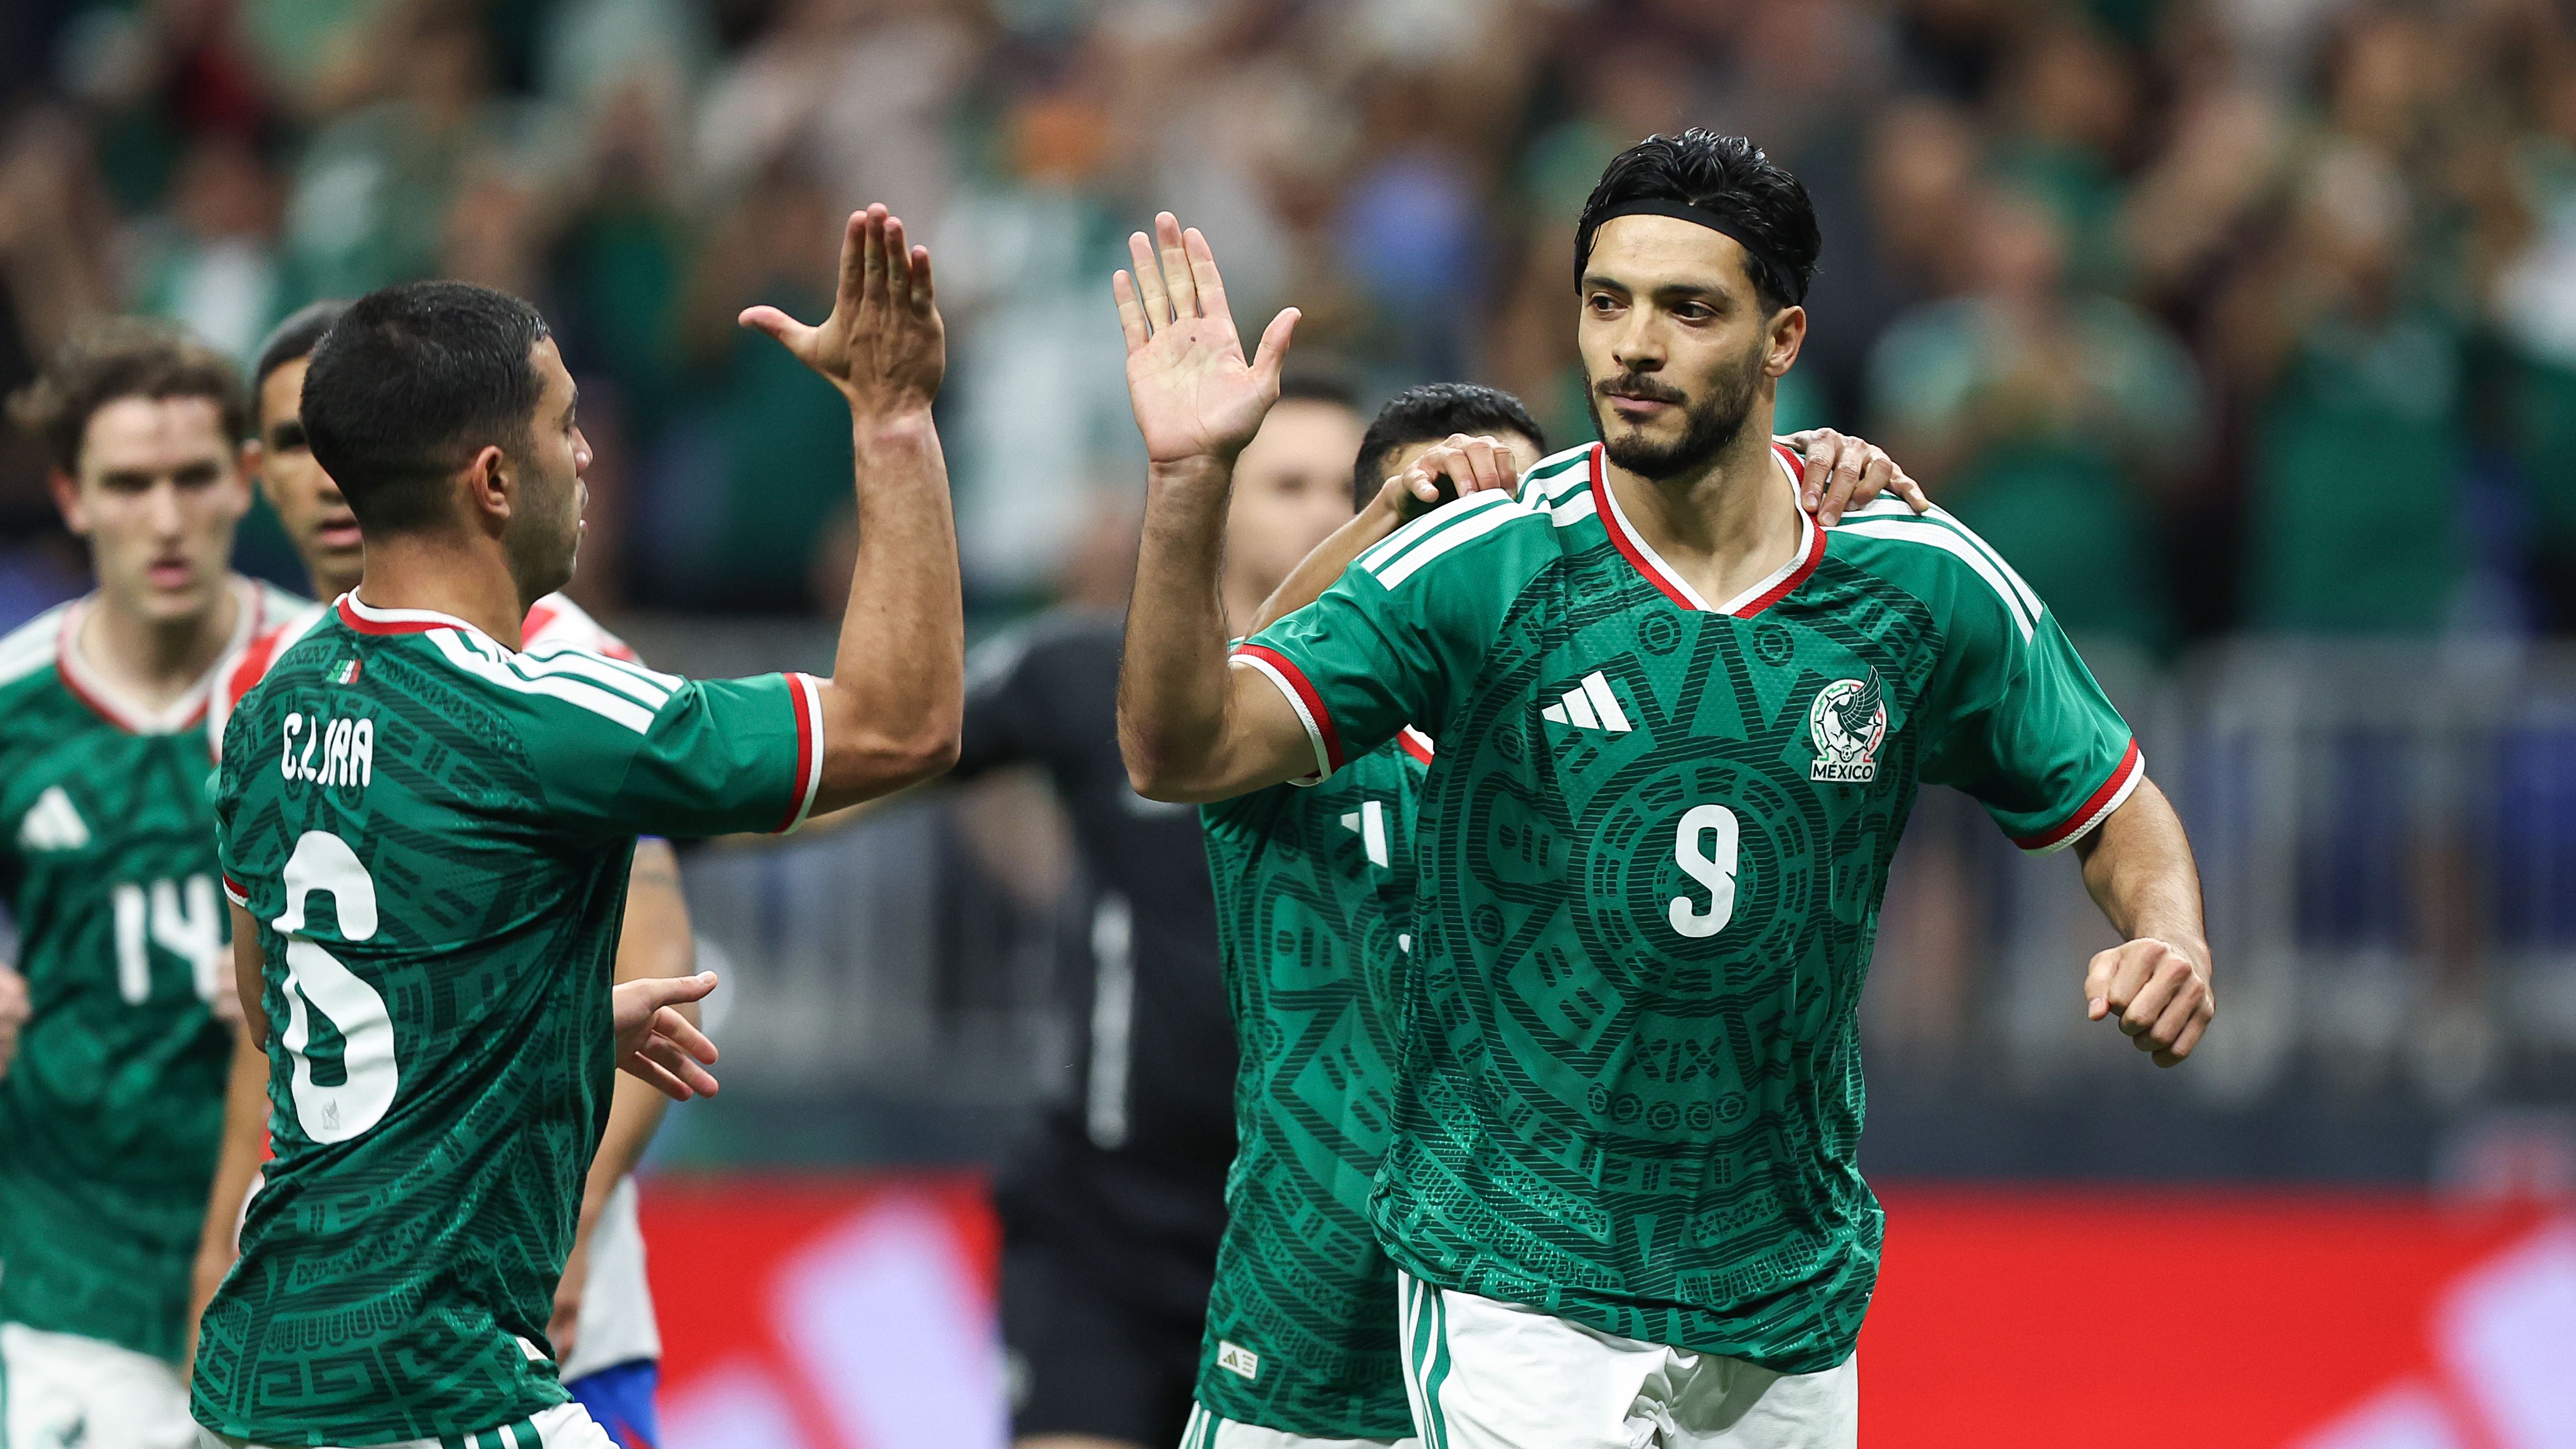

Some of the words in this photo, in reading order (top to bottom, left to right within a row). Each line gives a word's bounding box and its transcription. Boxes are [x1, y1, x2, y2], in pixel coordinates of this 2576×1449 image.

[1813, 761, 1873, 779] MÉXICO
[1669, 804, 1739, 938] 9
[113, 873, 223, 1005] 14
[271, 830, 398, 1145] 6
